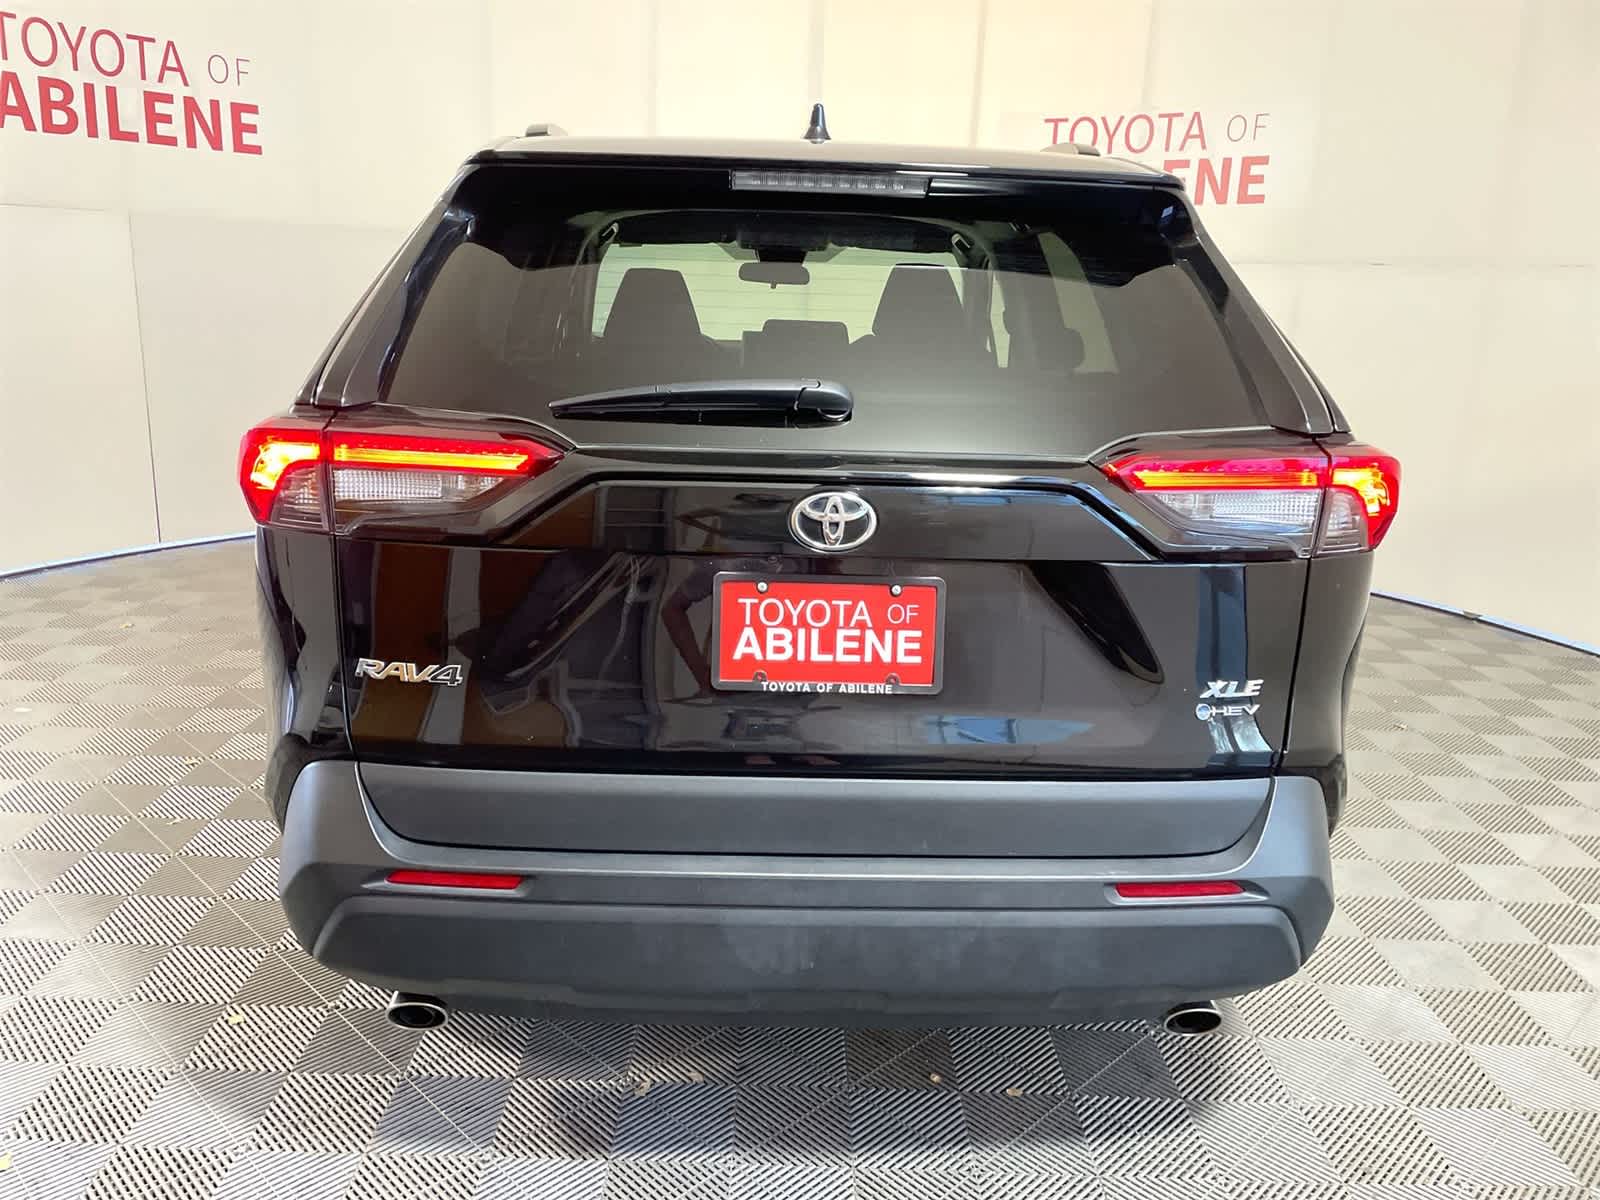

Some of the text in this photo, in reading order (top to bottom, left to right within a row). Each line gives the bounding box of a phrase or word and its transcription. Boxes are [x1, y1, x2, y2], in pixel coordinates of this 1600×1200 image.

[0, 11, 250, 87] TOYOTA OF
[0, 70, 262, 155] ABILENE
[1044, 111, 1270, 154] TOYOTA OF
[737, 598, 919, 628] TOYOTA OF
[732, 627, 922, 664] ABILENE
[354, 657, 463, 687] RAV4
[761, 681, 893, 694] TOYOTA OF ABILENE
[1199, 679, 1264, 699] XLE
